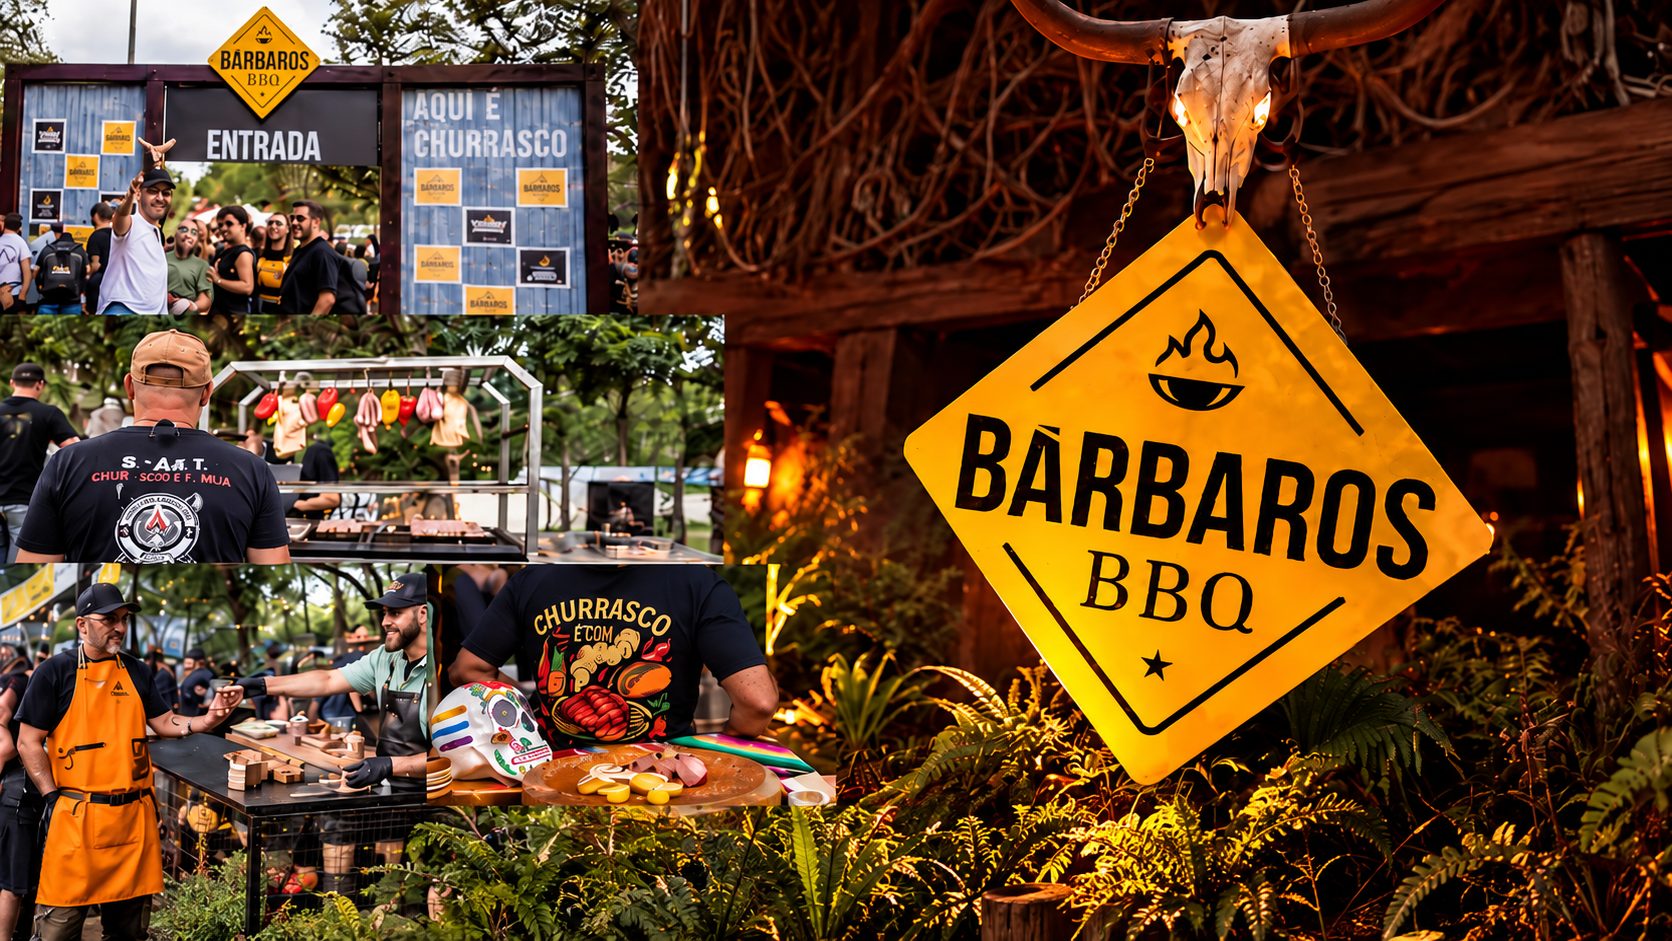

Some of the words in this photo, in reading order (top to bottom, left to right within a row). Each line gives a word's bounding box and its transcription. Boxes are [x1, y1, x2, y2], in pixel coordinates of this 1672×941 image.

[220, 49, 310, 71] BÁRBAROS
[247, 73, 280, 86] BBQ
[413, 92, 473, 122] AQUI
[485, 86, 500, 120] É
[206, 129, 322, 161] ENTRADA
[414, 129, 567, 158] CHURRASCO
[201, 473, 232, 488] MUA
[954, 412, 1437, 581] BÁRBAROS
[1080, 549, 1254, 635] BBQ
[534, 597, 672, 637] CHURRASCO
